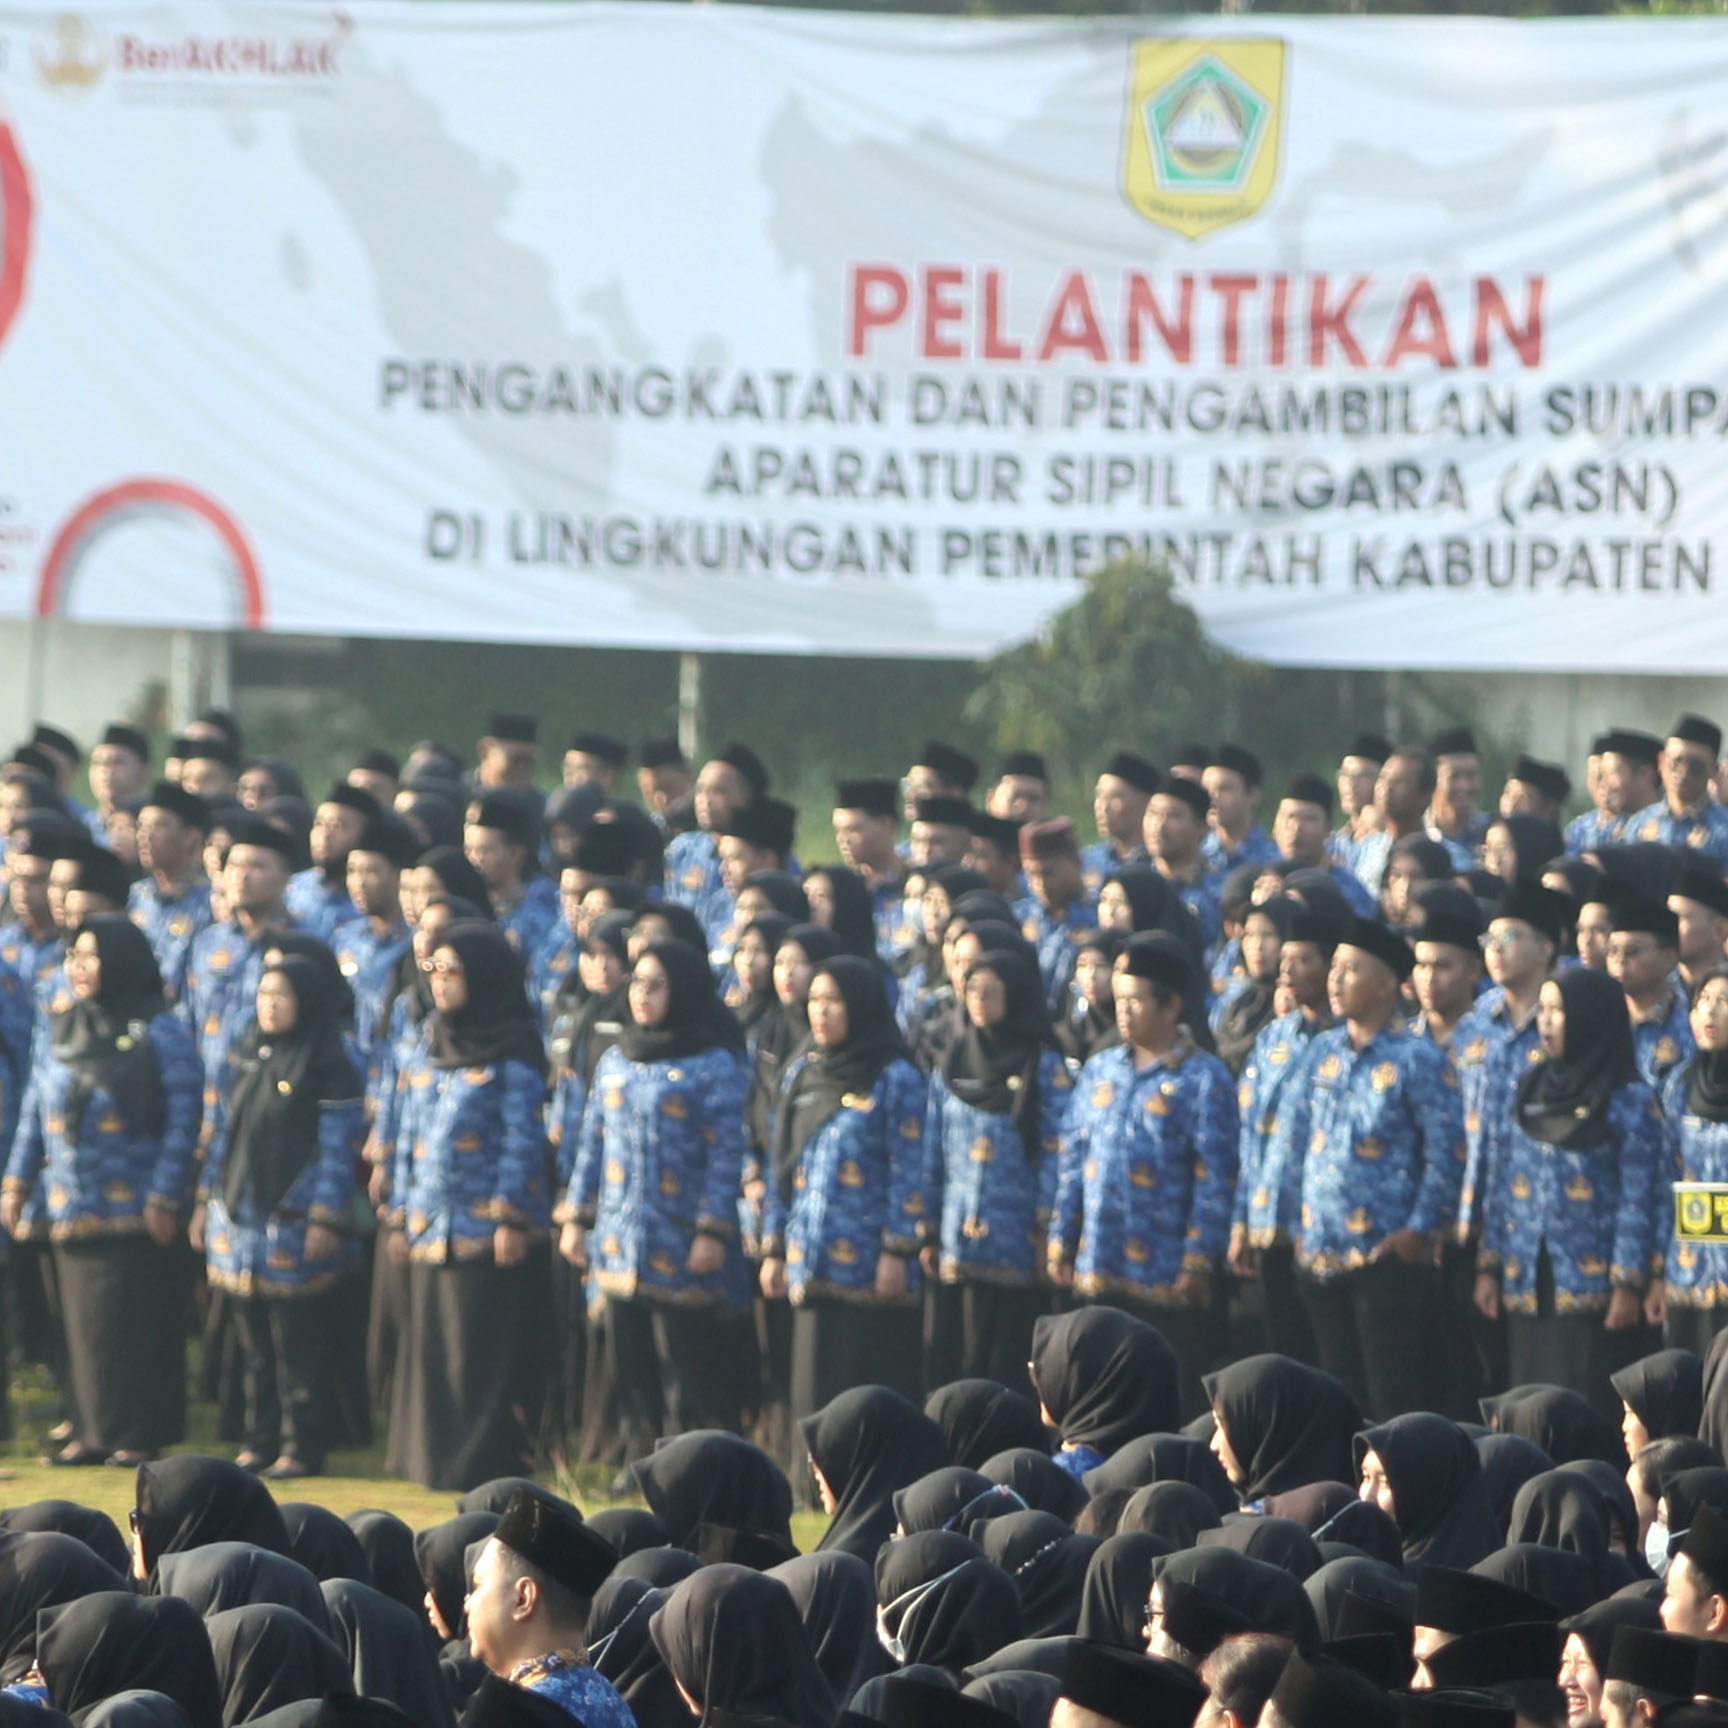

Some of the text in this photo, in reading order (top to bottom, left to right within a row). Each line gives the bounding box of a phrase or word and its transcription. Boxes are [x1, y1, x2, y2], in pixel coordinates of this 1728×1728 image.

[848, 264, 1544, 368] PELANTIKAN
[379, 362, 883, 426] PENGANGKATAN
[909, 377, 1040, 430] DAN
[1063, 379, 1518, 438] PENGAMBILAN
[706, 449, 1679, 526] APARATUR SIPIL NEGARA (ASN)
[425, 511, 485, 561] DI
[509, 515, 916, 573] LINGKUNGAN
[1354, 536, 1710, 591] KABUPATEN
